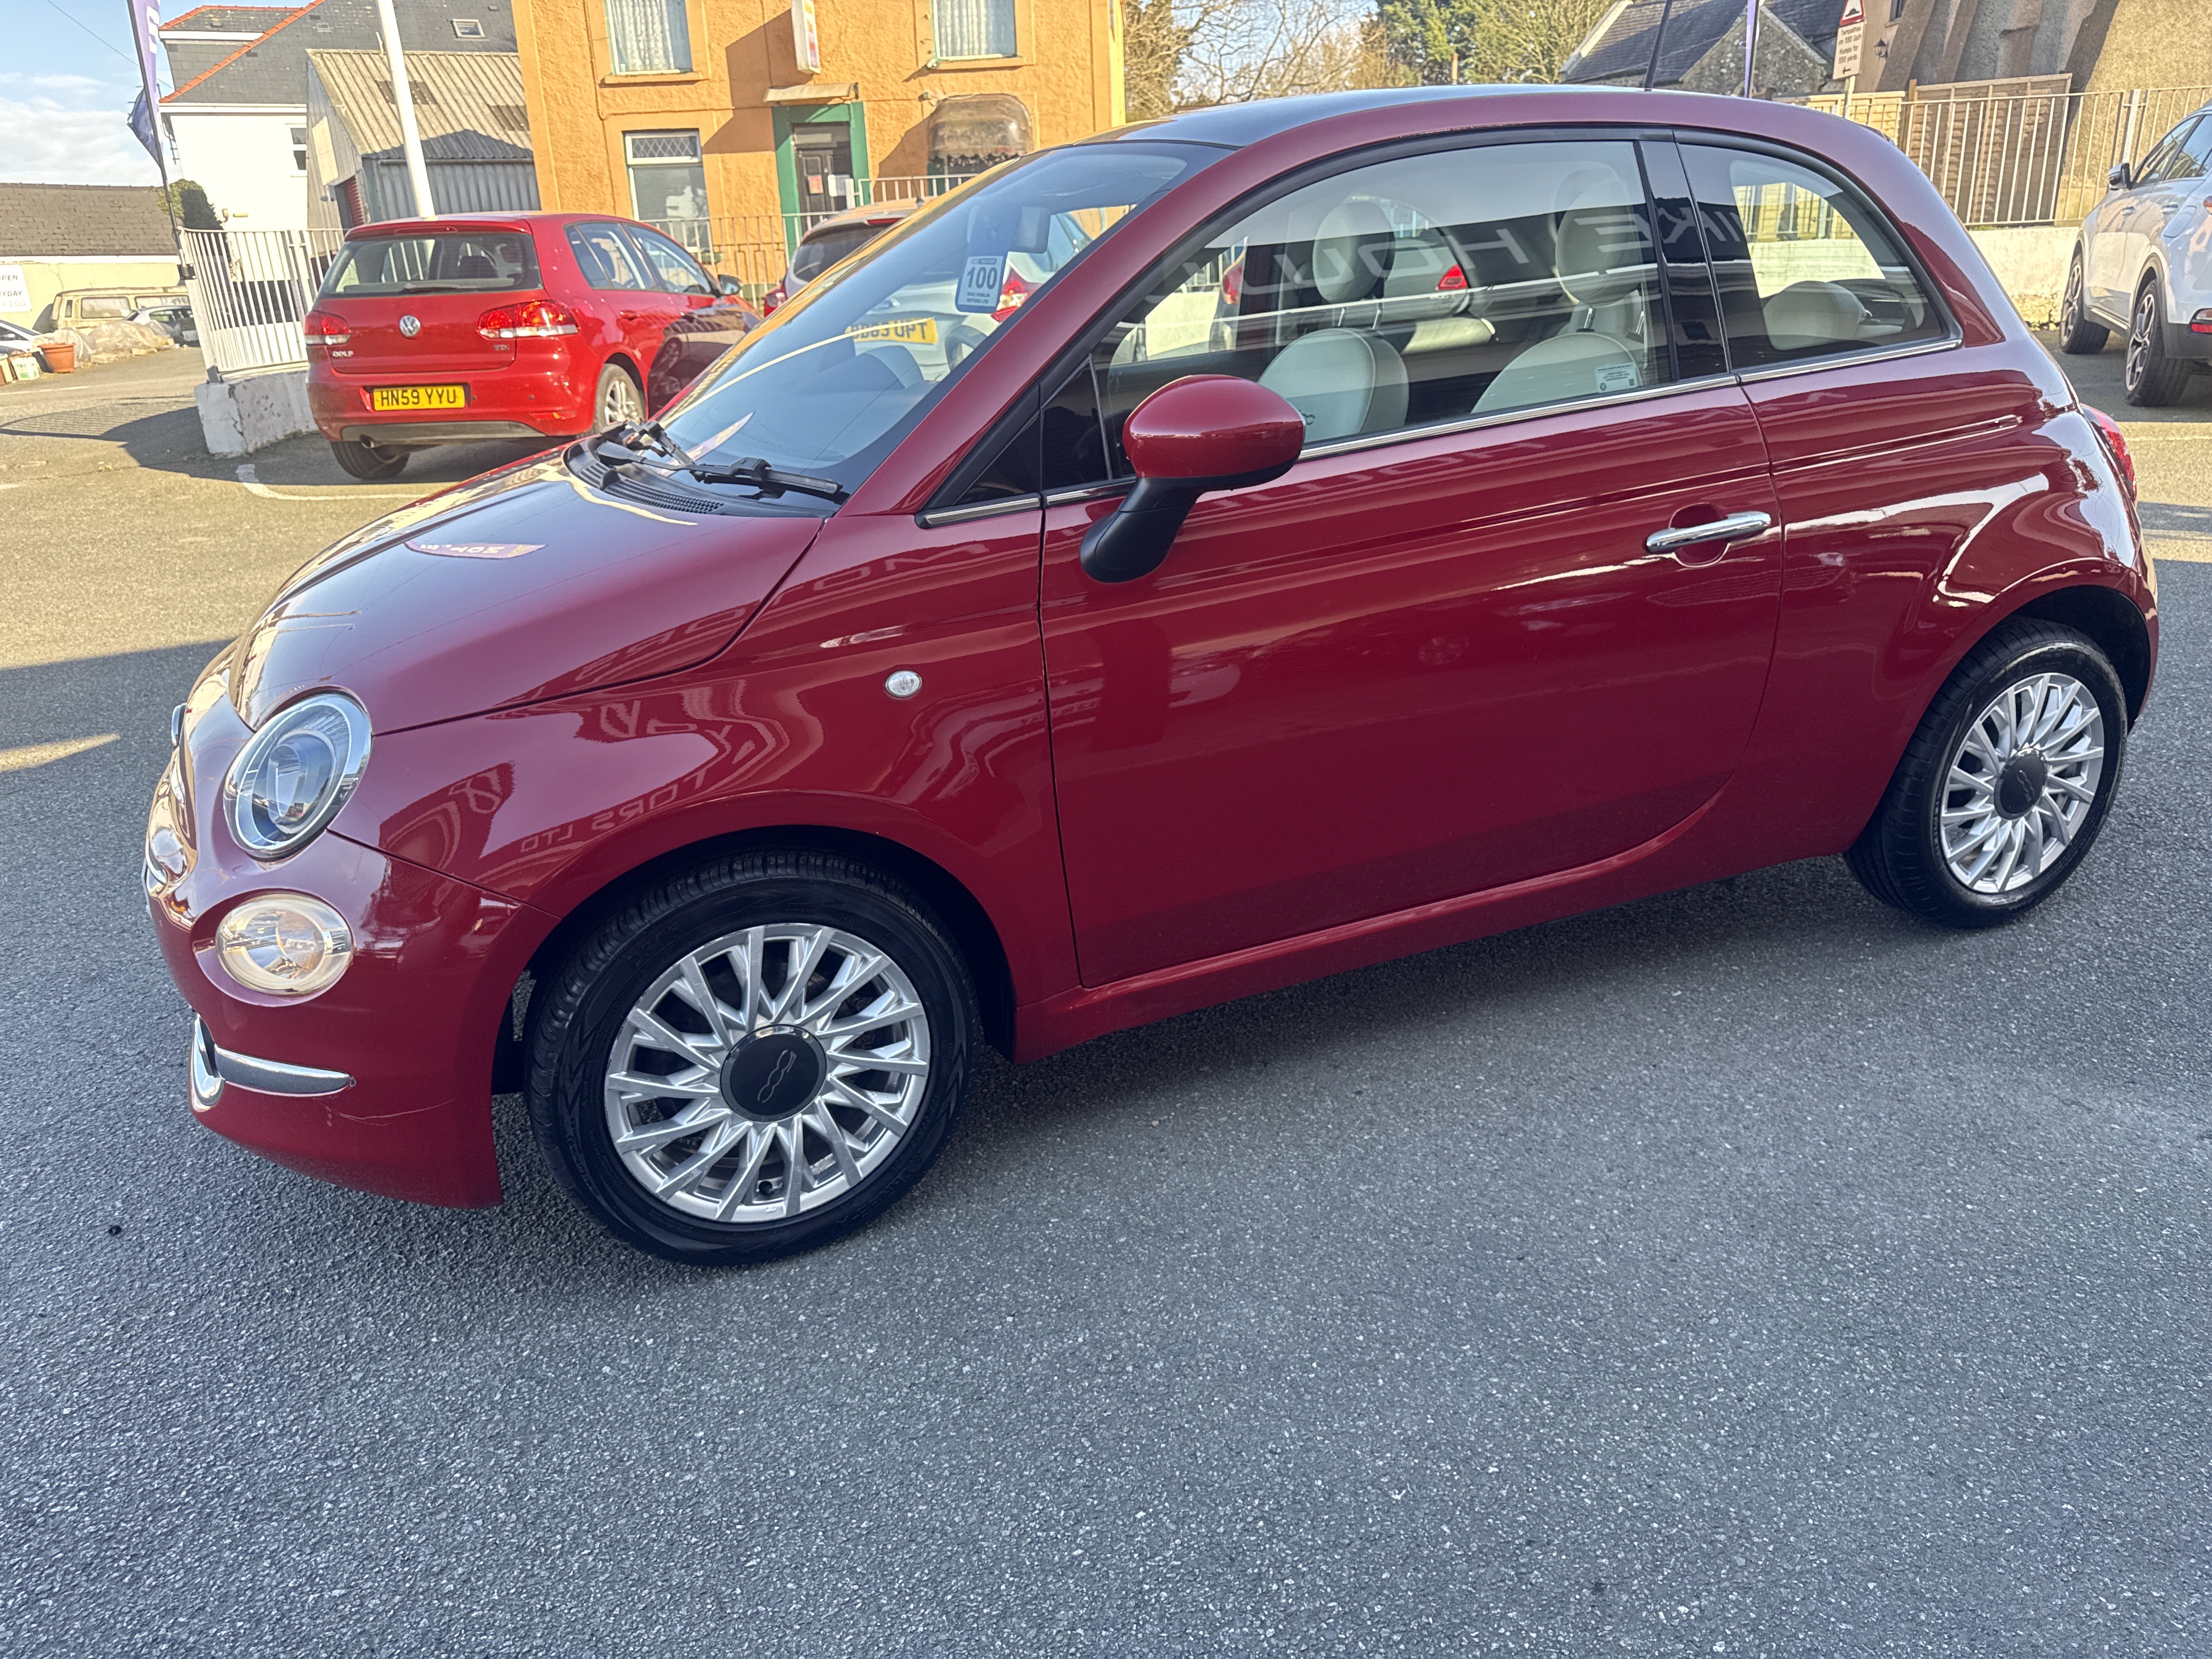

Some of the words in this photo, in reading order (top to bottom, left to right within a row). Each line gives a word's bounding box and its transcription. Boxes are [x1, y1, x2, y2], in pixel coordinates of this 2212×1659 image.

[966, 267, 998, 290] 100
[381, 390, 420, 407] HN59
[425, 388, 456, 405] YYU
